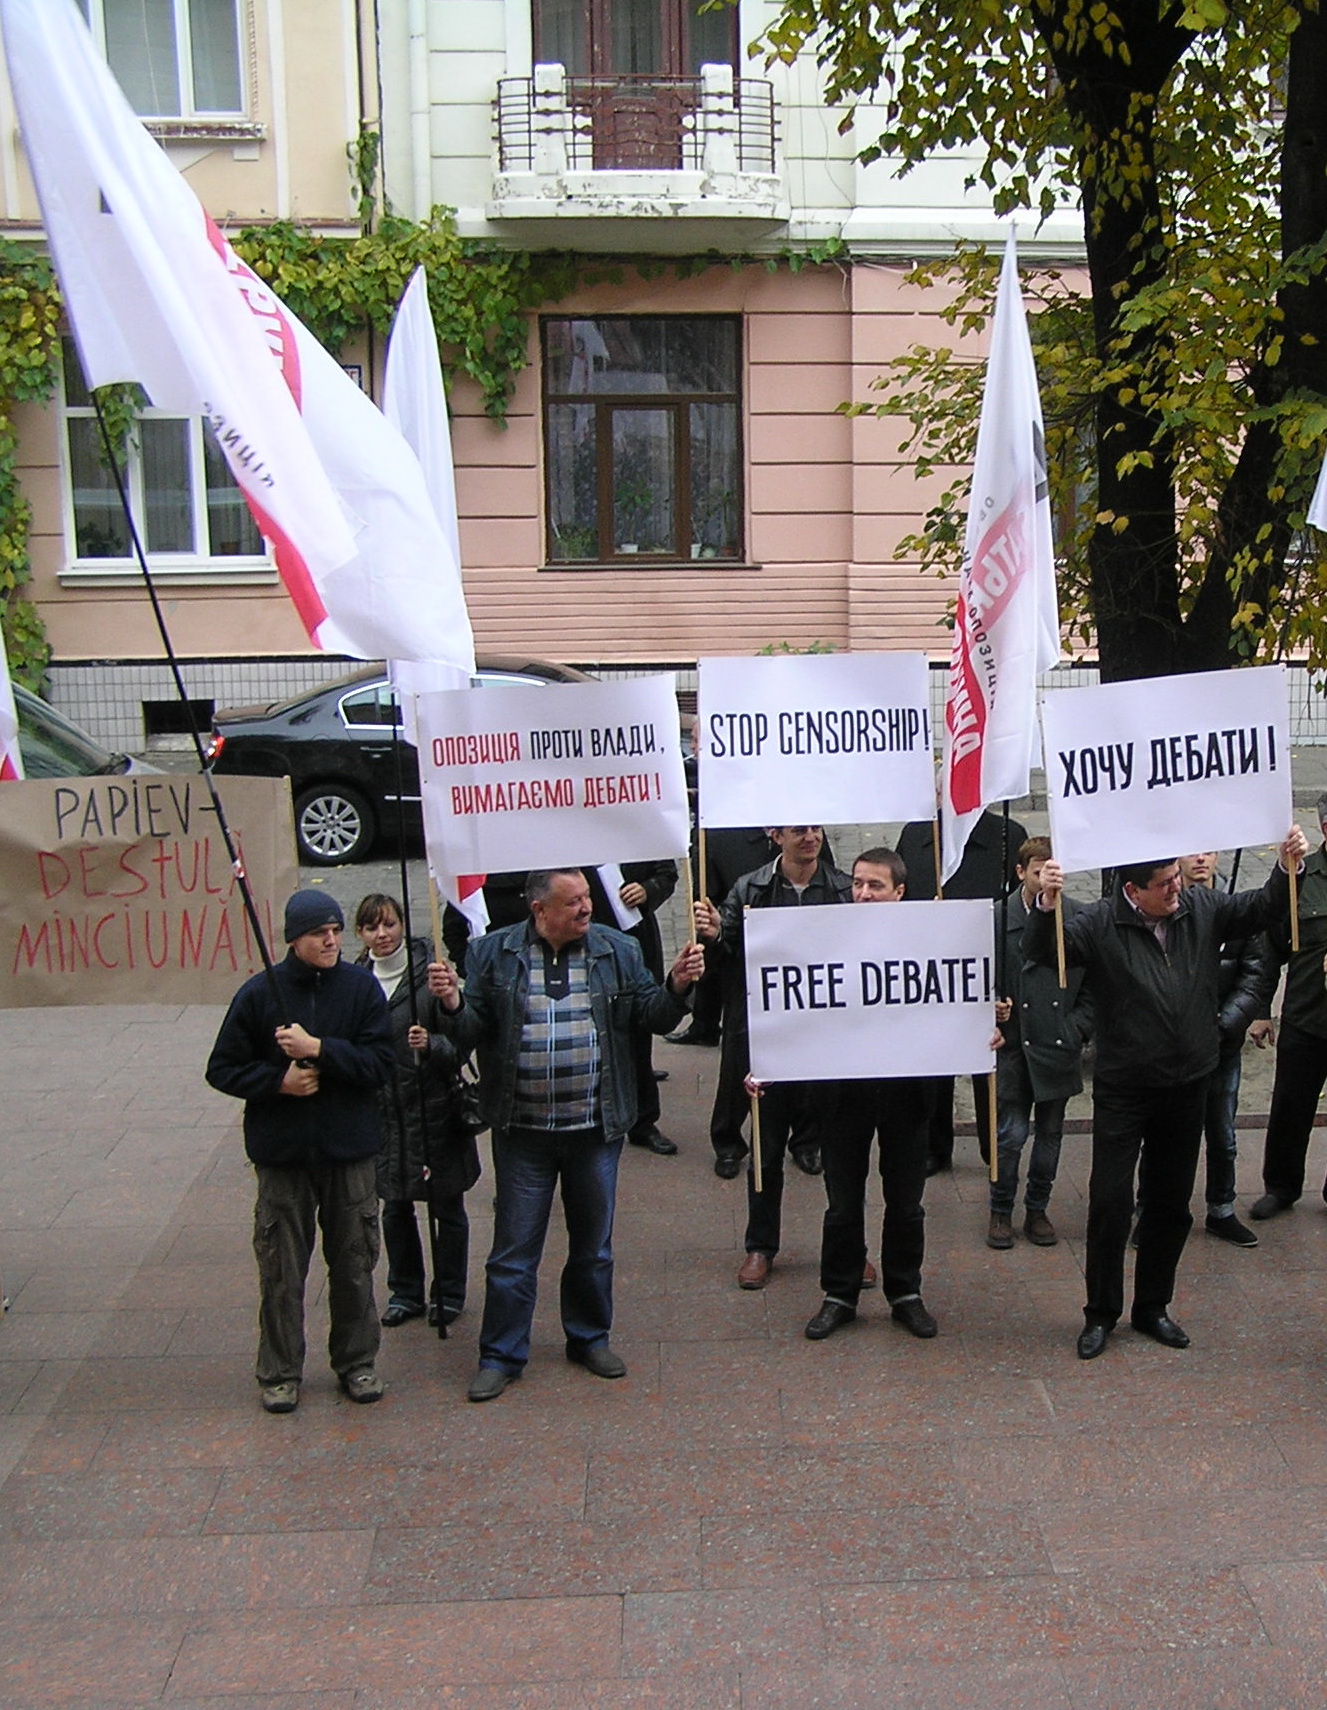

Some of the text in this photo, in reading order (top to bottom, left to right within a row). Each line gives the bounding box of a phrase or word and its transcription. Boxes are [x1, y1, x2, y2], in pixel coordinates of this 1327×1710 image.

[432, 723, 665, 767] ОПОЗИЦІЯ ПРОТИ ВЛАДИ,
[710, 708, 930, 757] STOP CENSORSHIP!
[1058, 725, 1276, 798] ХОЧУ ДЕБАТИ!
[451, 772, 661, 815] ВИМАГАЄМО ДЕБАТИ!
[761, 957, 990, 1011] FREE DEBATE!
